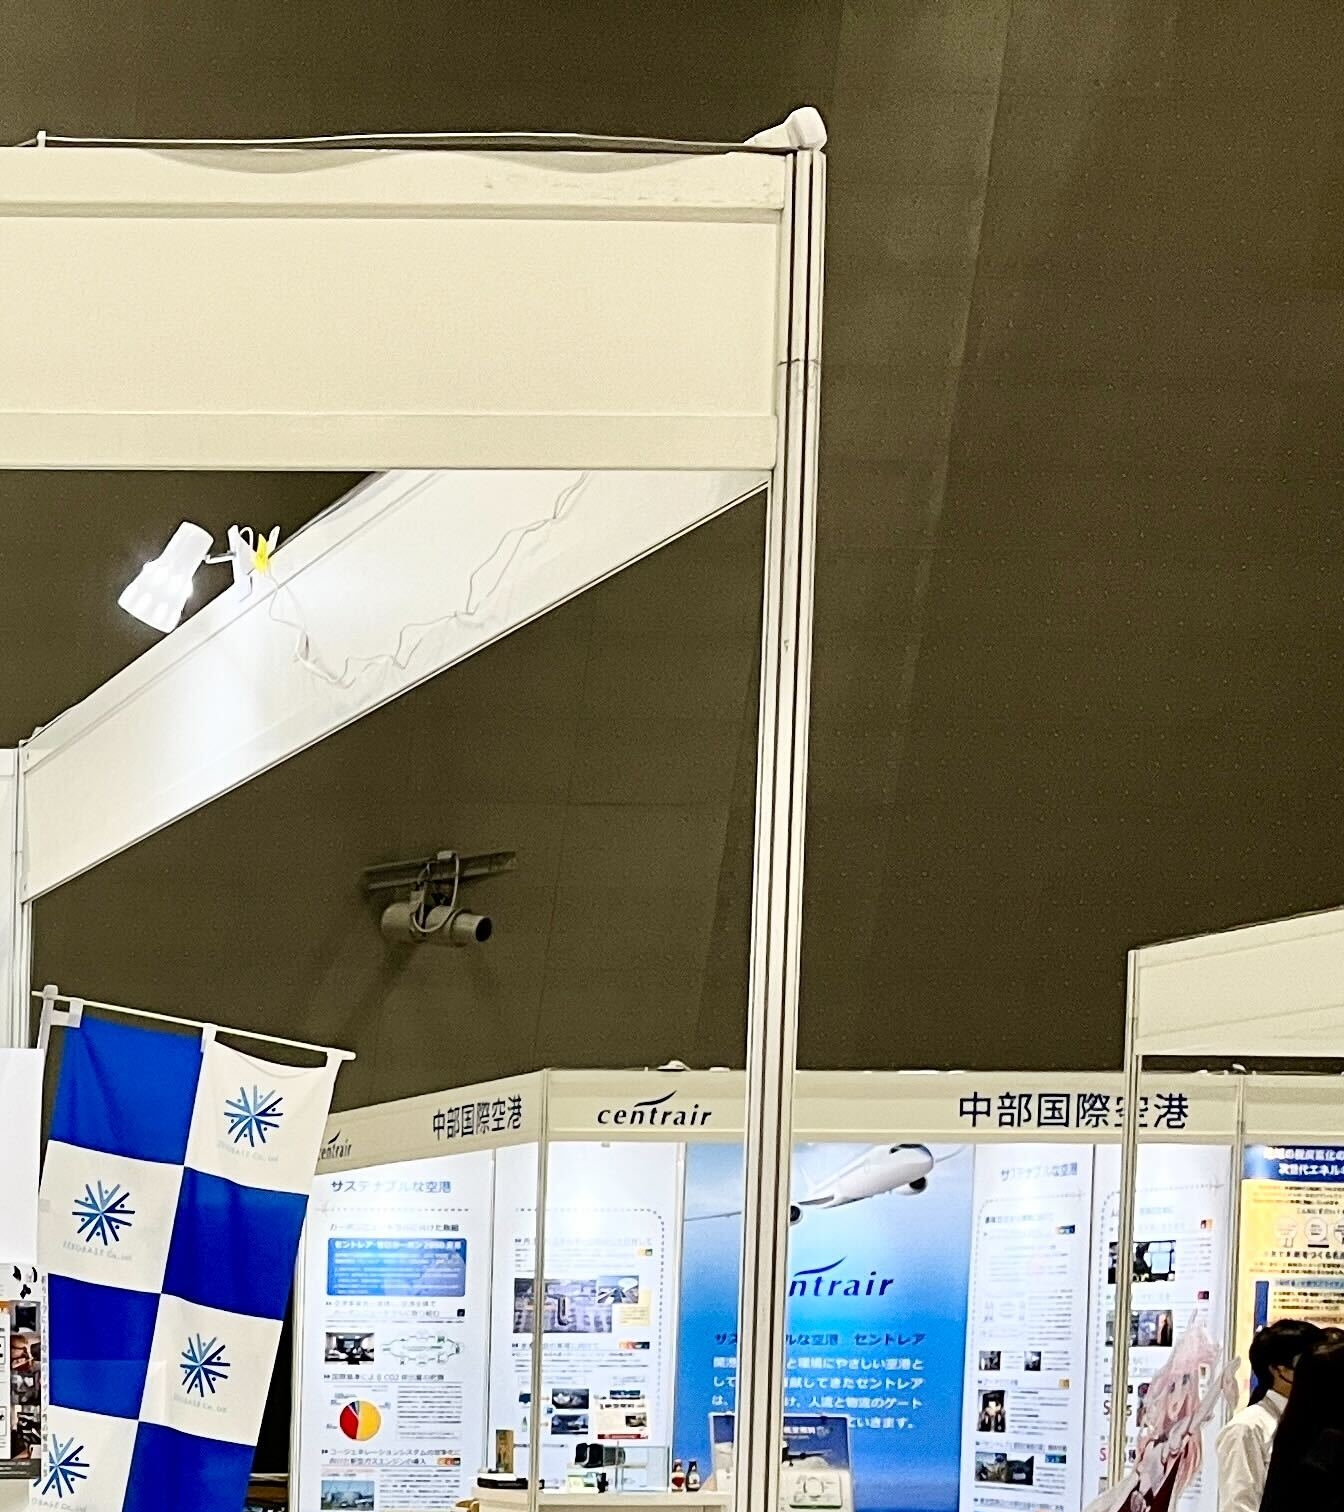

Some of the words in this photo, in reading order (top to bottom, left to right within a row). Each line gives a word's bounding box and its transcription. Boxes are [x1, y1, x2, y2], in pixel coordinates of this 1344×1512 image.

[432, 1094, 522, 1141] 中部国際空港
[597, 1091, 713, 1127] centrair
[959, 1091, 1189, 1129] 中部国際空港
[788, 1258, 895, 1297] ntrair
[855, 1333, 926, 1346] セントレア
